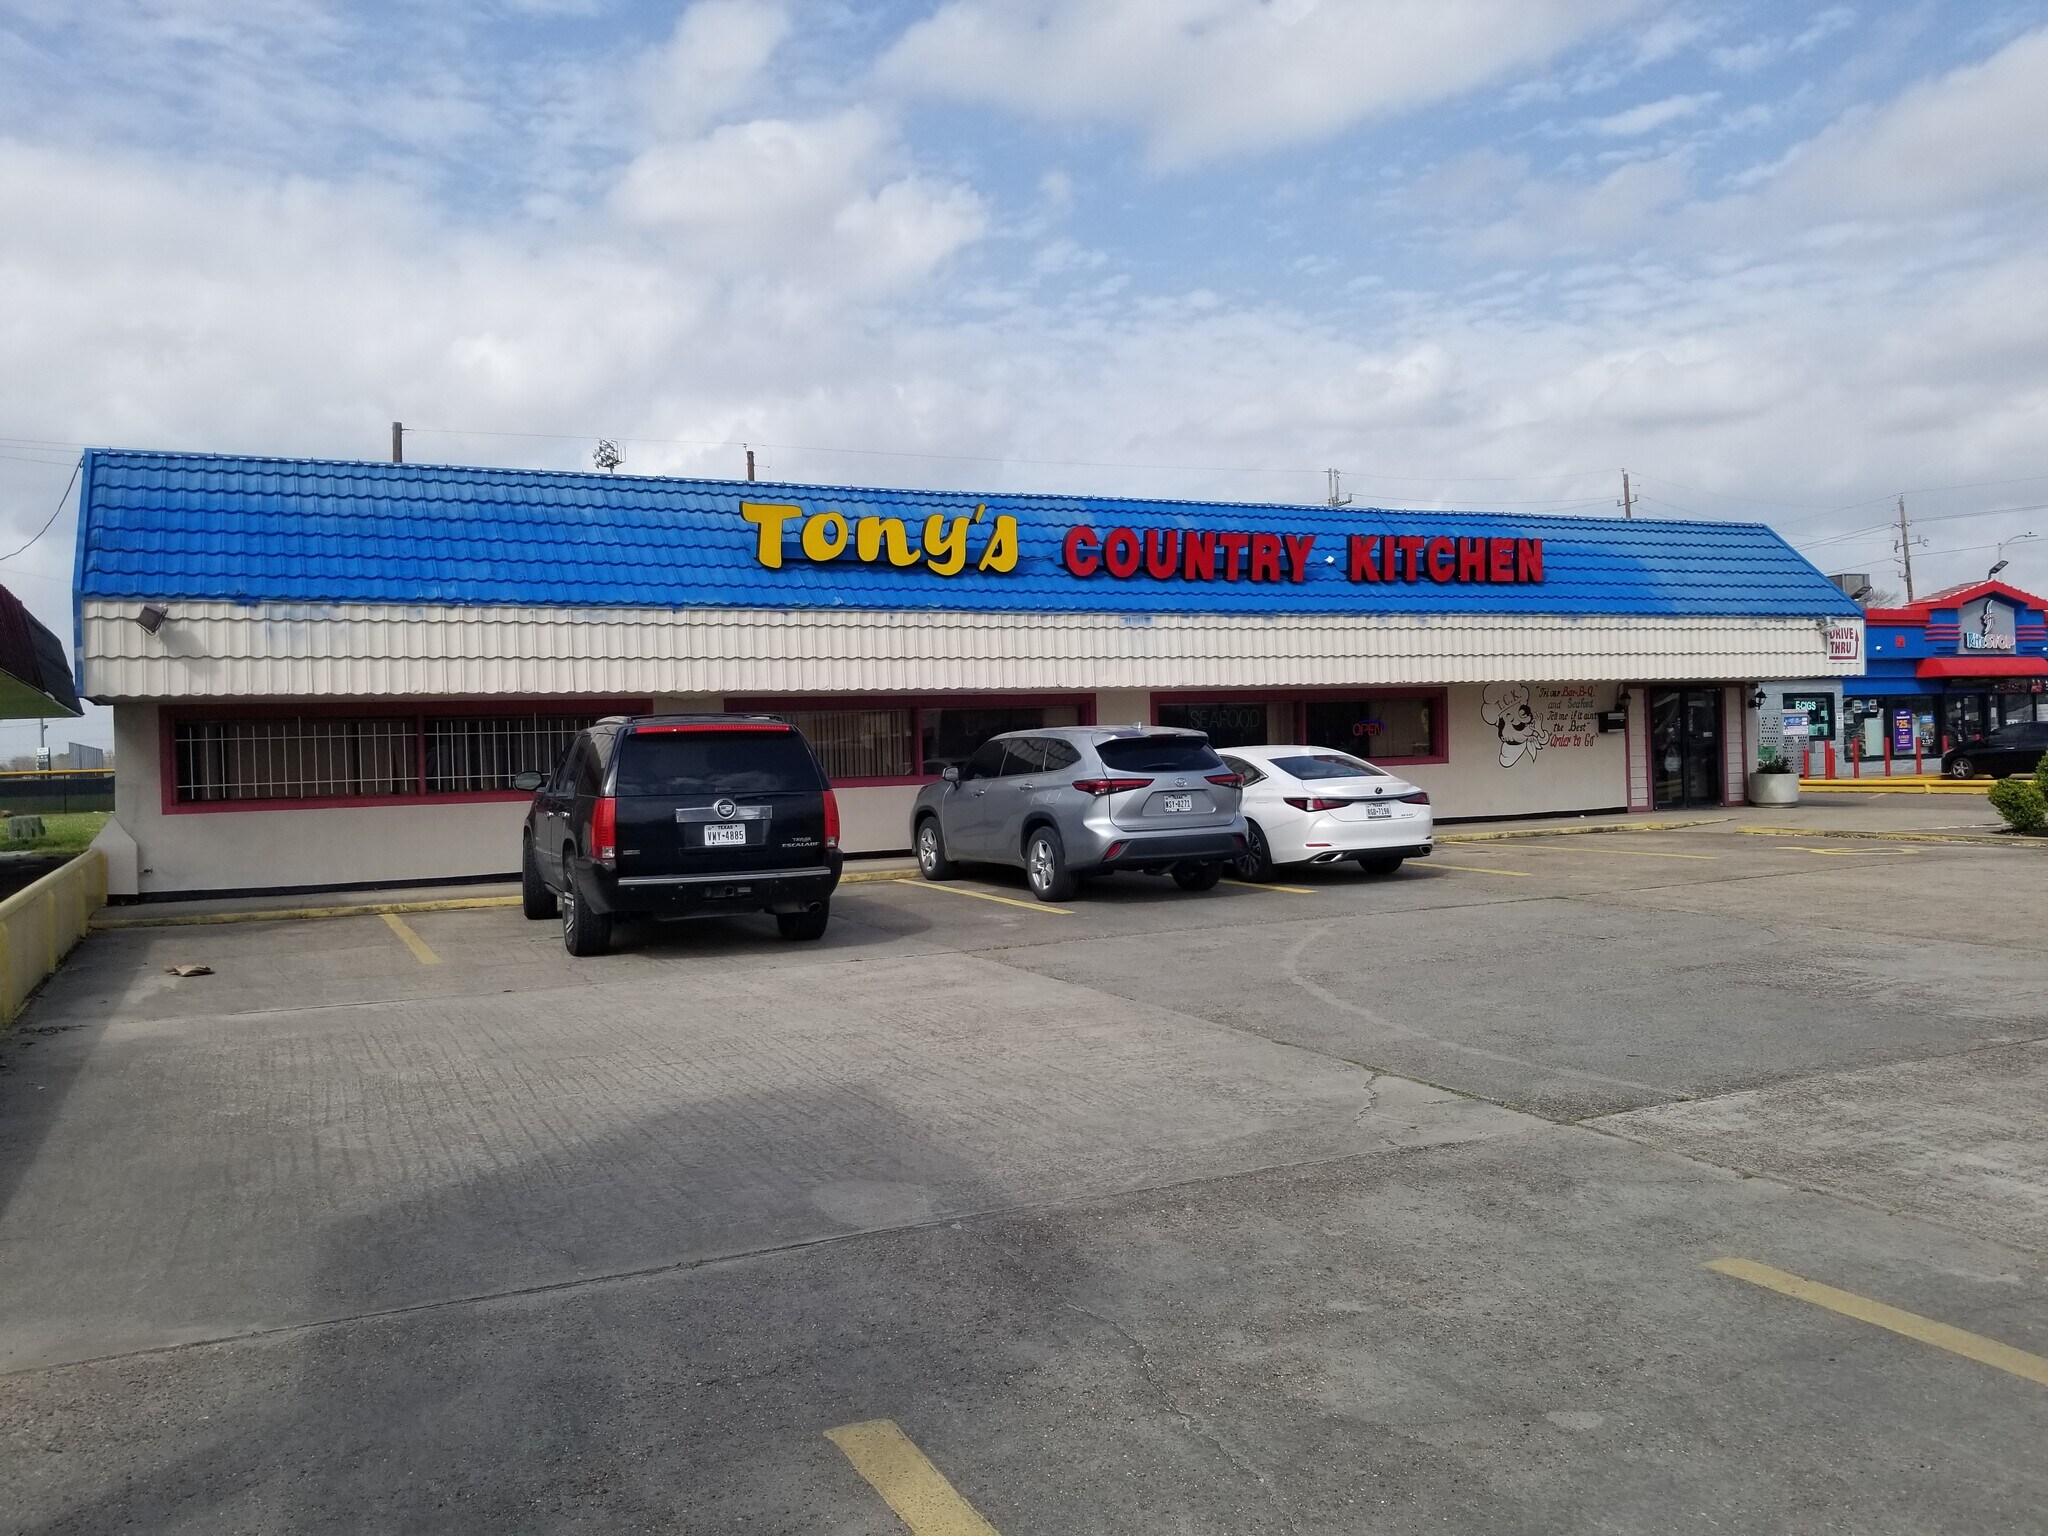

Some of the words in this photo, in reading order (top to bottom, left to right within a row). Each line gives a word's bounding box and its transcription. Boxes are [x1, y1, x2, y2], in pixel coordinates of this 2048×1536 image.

[739, 501, 1019, 577] Tony's
[1061, 525, 1317, 583] COUNTRY
[1346, 535, 1544, 583] KITCHEN
[1829, 627, 1854, 640] DRIVE
[1829, 641, 1852, 654] THRU
[1190, 709, 1261, 729] SEAFOOD
[1352, 723, 1384, 737] OPEN
